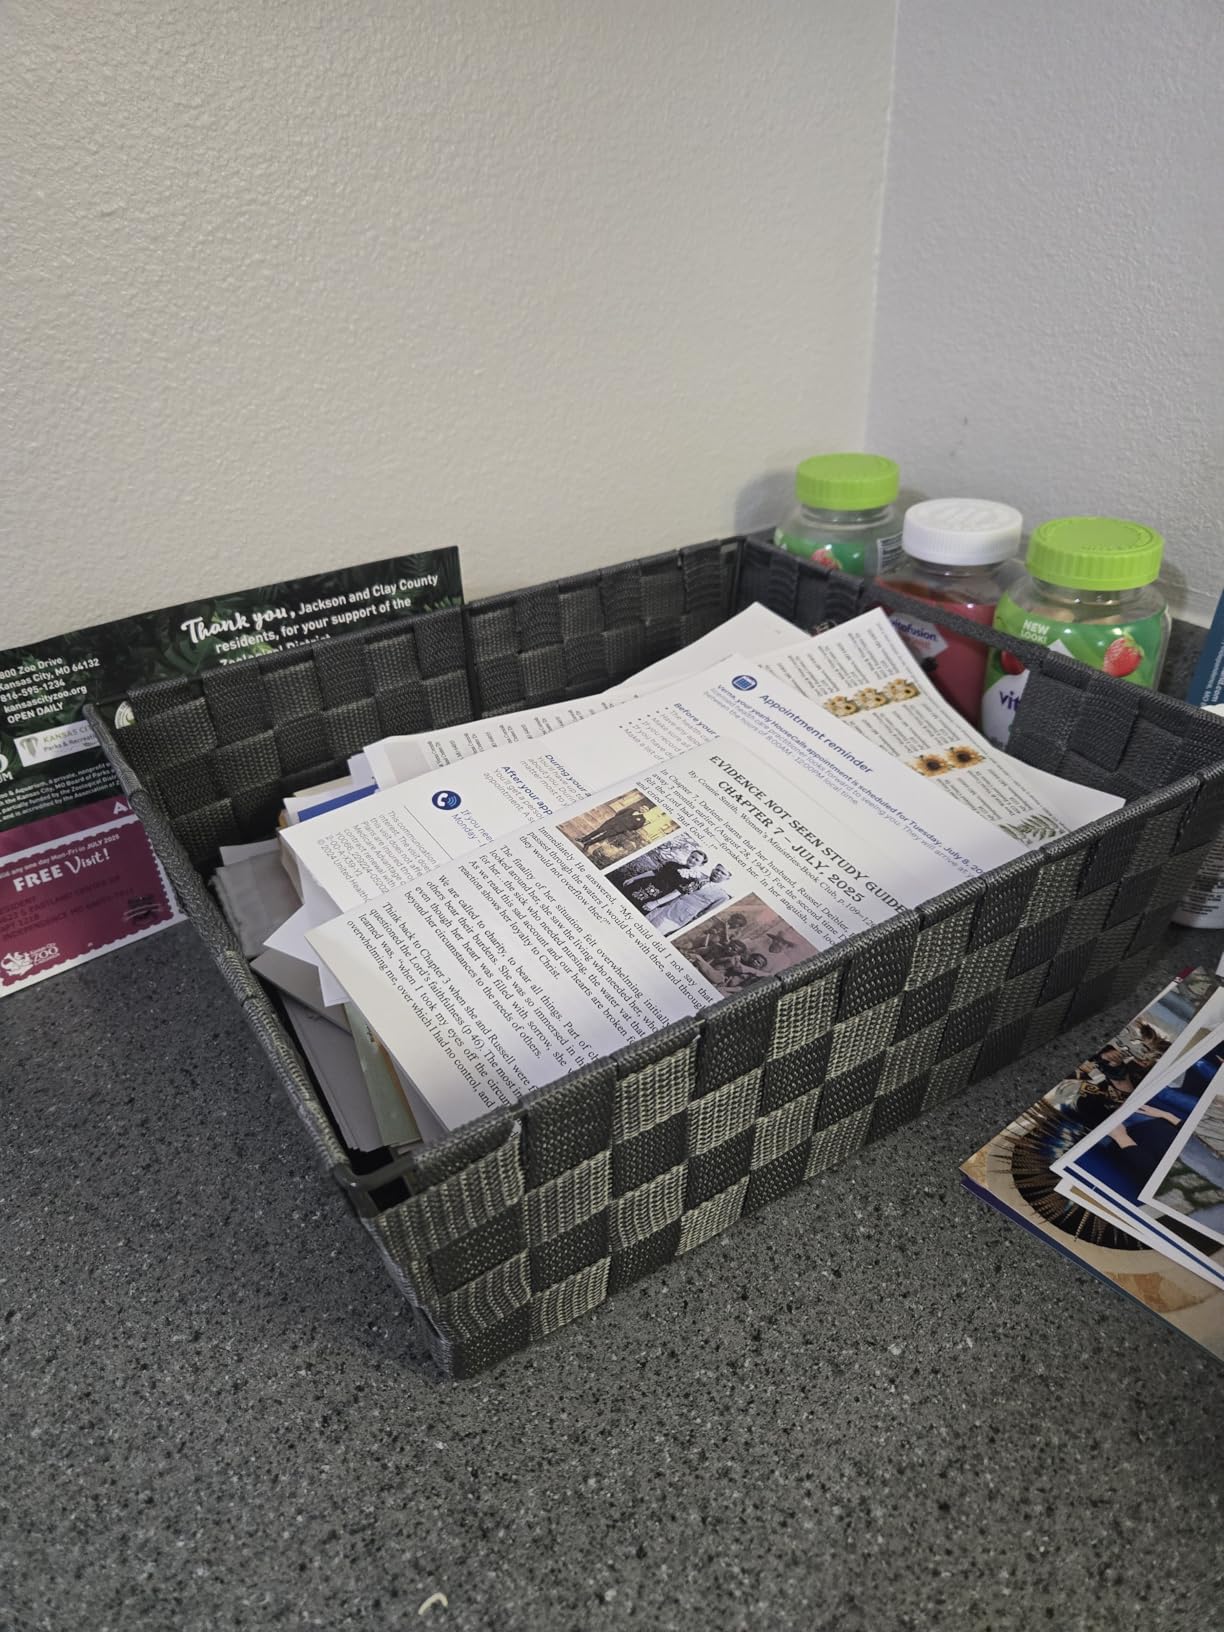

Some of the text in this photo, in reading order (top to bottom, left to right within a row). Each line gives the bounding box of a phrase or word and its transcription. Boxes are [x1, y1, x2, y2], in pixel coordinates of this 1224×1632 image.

[181, 574, 438, 643] Thank you, Jackson and Clay County
[216, 631, 279, 654] residents,
[281, 624, 299, 637] for
[302, 618, 328, 634] your
[331, 604, 377, 624] support
[379, 601, 390, 613] of
[392, 597, 411, 609] the
[1024, 619, 1050, 635] NEW
[0, 679, 66, 702] 816-595-1234
[17, 664, 36, 675] Zoo
[37, 658, 62, 669] Drive
[32, 672, 54, 682] City,
[55, 666, 70, 676] MO
[72, 658, 100, 672] 64132
[3, 685, 88, 713] kansascityzoo.org
[7, 702, 64, 724] OPEN DAILY
[673, 702, 718, 738] Before your
[757, 694, 827, 743] Appointment
[822, 735, 875, 777] reminder
[500, 765, 525, 785] After
[516, 783, 540, 802] your
[542, 753, 588, 793] During your
[769, 720, 809, 750] HouseCalls
[805, 746, 854, 783] appointment
[850, 777, 860, 787] is
[857, 784, 899, 814] scheduled
[895, 811, 911, 822] for
[905, 819, 945, 848] Tuesday,
[942, 846, 963, 861] July
[386, 810, 438, 865] This communication
[449, 812, 480, 841] Monday
[459, 808, 473, 818] If
[463, 814, 483, 831] you
[688, 770, 699, 779] By
[697, 778, 720, 797] Connie
[718, 795, 738, 815] Smith,
[740, 812, 768, 839] Women's
[767, 837, 820, 883] Ministries-Book
[819, 881, 837, 900] Club,
[708, 755, 909, 916] EVIDENCE NOT SEEN STUDY GUIDE
[718, 780, 774, 829] CHAPTER
[773, 826, 785, 835] 7
[791, 845, 831, 875] JULY,
[827, 873, 866, 903] 2025
[13, 864, 63, 892] FREE
[64, 848, 110, 874] Visit!
[319, 843, 340, 861] 2024
[330, 858, 356, 881] United
[340, 827, 399, 889] contract renewal with
[349, 823, 405, 881] Medicare Advantage
[660, 768, 849, 933] In Chapter 7, Darlene learns that her husband, Russel Deibler,
[457, 865, 561, 980] reaction shows her loyalty to Christ.
[499, 844, 670, 1028] The finality of her situation felt overwhelming initially
[537, 826, 576, 864] Immediately
[574, 861, 586, 873] He
[585, 873, 617, 905] answered,
[619, 904, 634, 921] "My
[633, 922, 654, 940] child
[651, 941, 667, 954] did
[669, 960, 685, 973] not
[683, 973, 698, 987] say
[697, 987, 714, 1004] that
[382, 901, 531, 1086] Think back to Chapter 3 when she and Russell were
[404, 890, 542, 1059] beyond her circumstances to the needs of others.
[346, 920, 496, 1109] overwhelming me, over which I had no control, and
